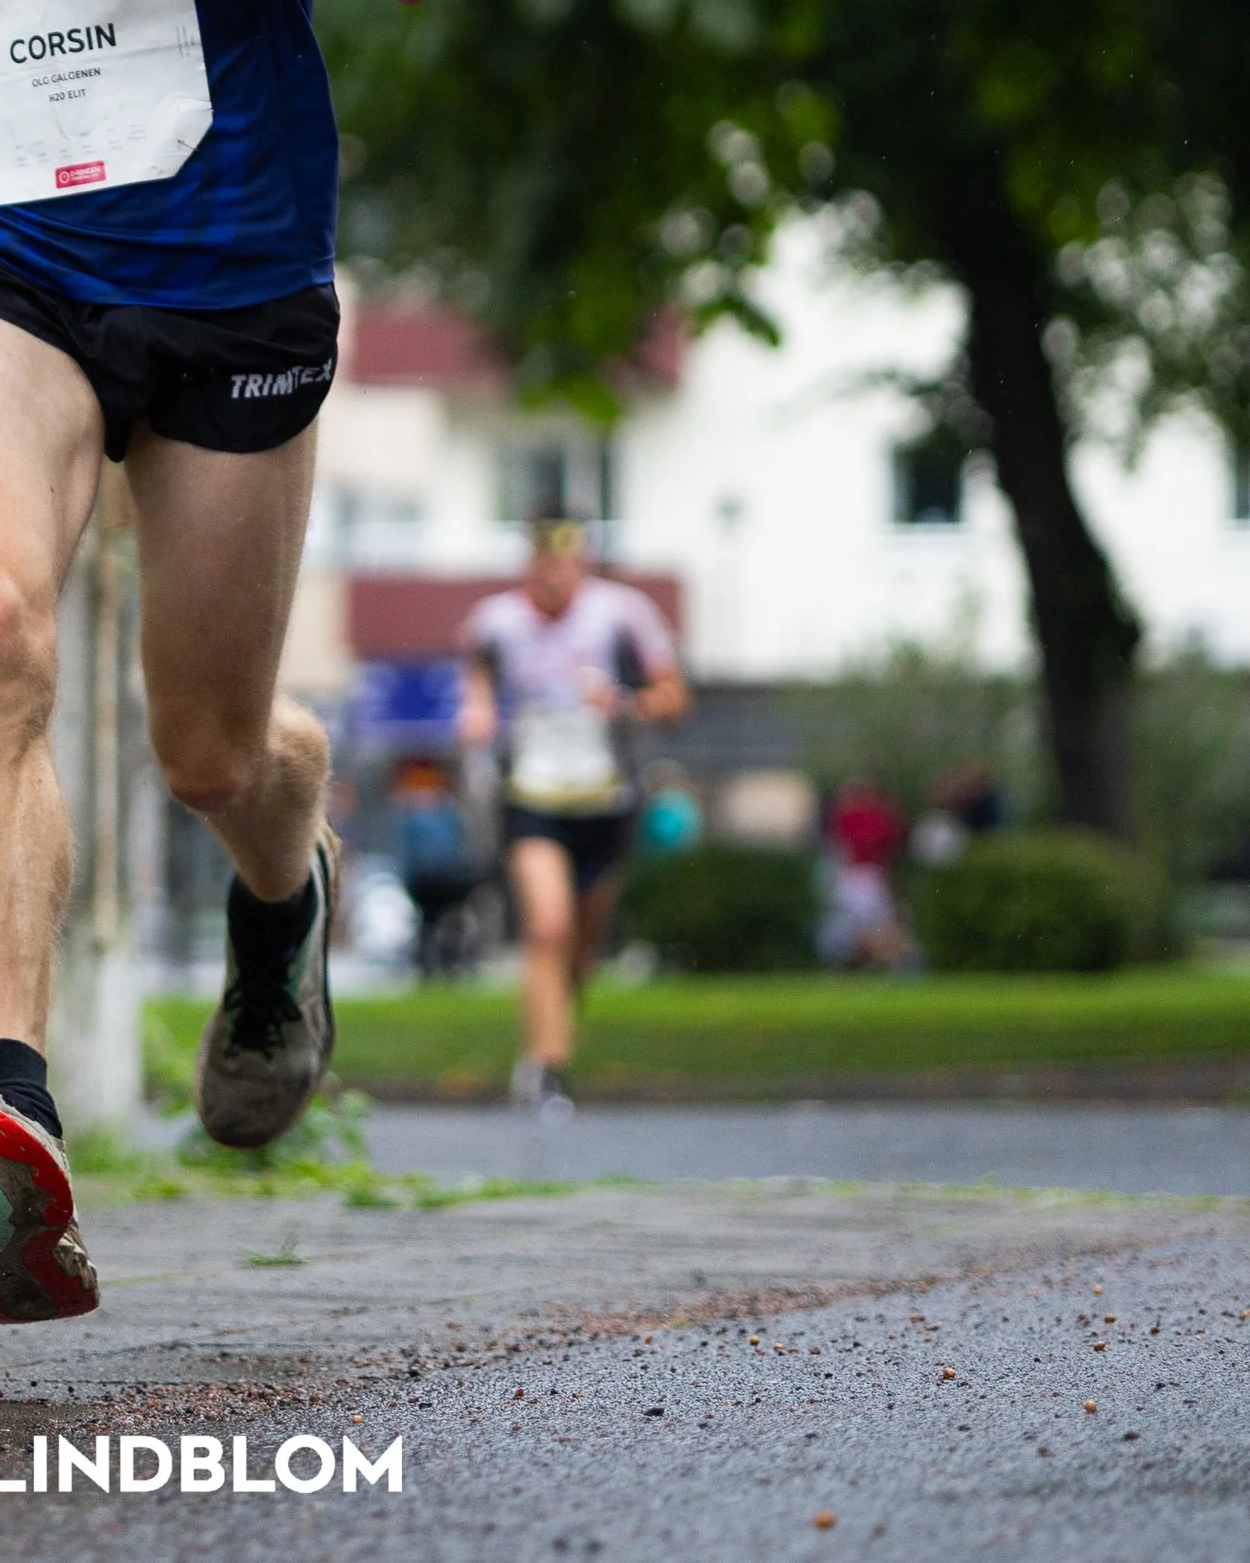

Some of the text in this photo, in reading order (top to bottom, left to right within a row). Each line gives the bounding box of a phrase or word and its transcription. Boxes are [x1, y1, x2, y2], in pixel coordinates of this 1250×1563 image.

[10, 23, 117, 64] CORSIN
[51, 67, 101, 83] GALGENEN
[68, 88, 86, 99] ELIT
[231, 358, 332, 399] TRIMTEX
